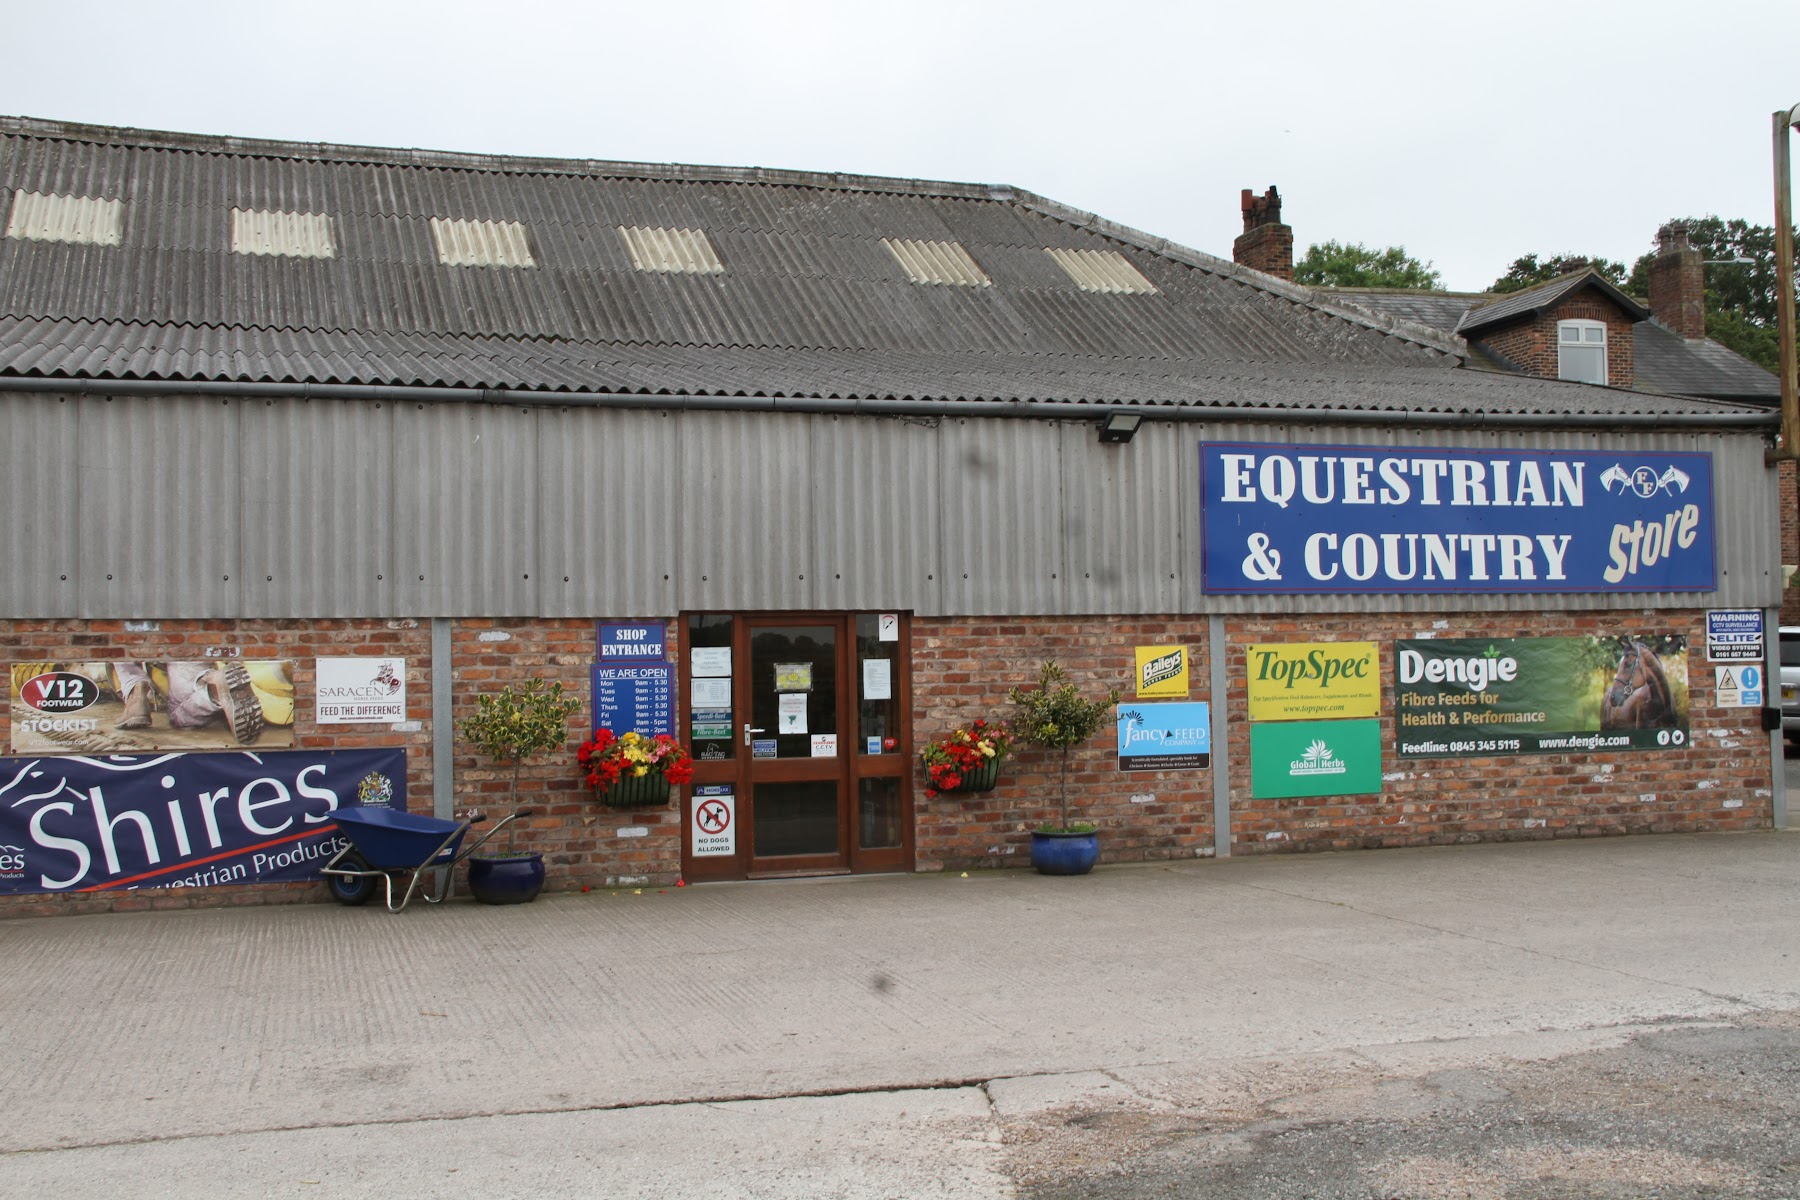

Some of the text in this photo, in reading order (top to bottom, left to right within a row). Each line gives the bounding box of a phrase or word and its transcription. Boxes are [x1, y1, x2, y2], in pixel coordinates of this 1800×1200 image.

[1220, 454, 1585, 509] EQUESTRIAN
[1241, 532, 1572, 581] & COUNTRY
[1711, 613, 1760, 622] WARNING
[616, 628, 648, 641] SHOP
[1717, 634, 1755, 642] ELITE
[601, 643, 662, 656] ENTRANCE
[1143, 651, 1181, 681] Baileys
[1400, 649, 1518, 691] Dengie
[599, 668, 668, 678] WE ARE OPEN
[35, 679, 84, 698] V12
[319, 686, 384, 697] SARACEN
[36, 699, 84, 707] FOOTWEAR
[1402, 691, 1499, 706] Fibre Feeds for
[320, 705, 401, 716] FEED THE DIFFERENCE
[1283, 705, 1345, 713] www.topspec.com
[1402, 710, 1546, 726] Health & Performance
[20, 719, 98, 732] STOCKIST
[1124, 719, 1206, 750] fancy FEED
[1539, 733, 1630, 749] www.dengie.com
[1402, 739, 1520, 753] Feedline: 0845 345 5115
[1290, 758, 1345, 769] Global Herbs
[29, 764, 339, 890] Shires
